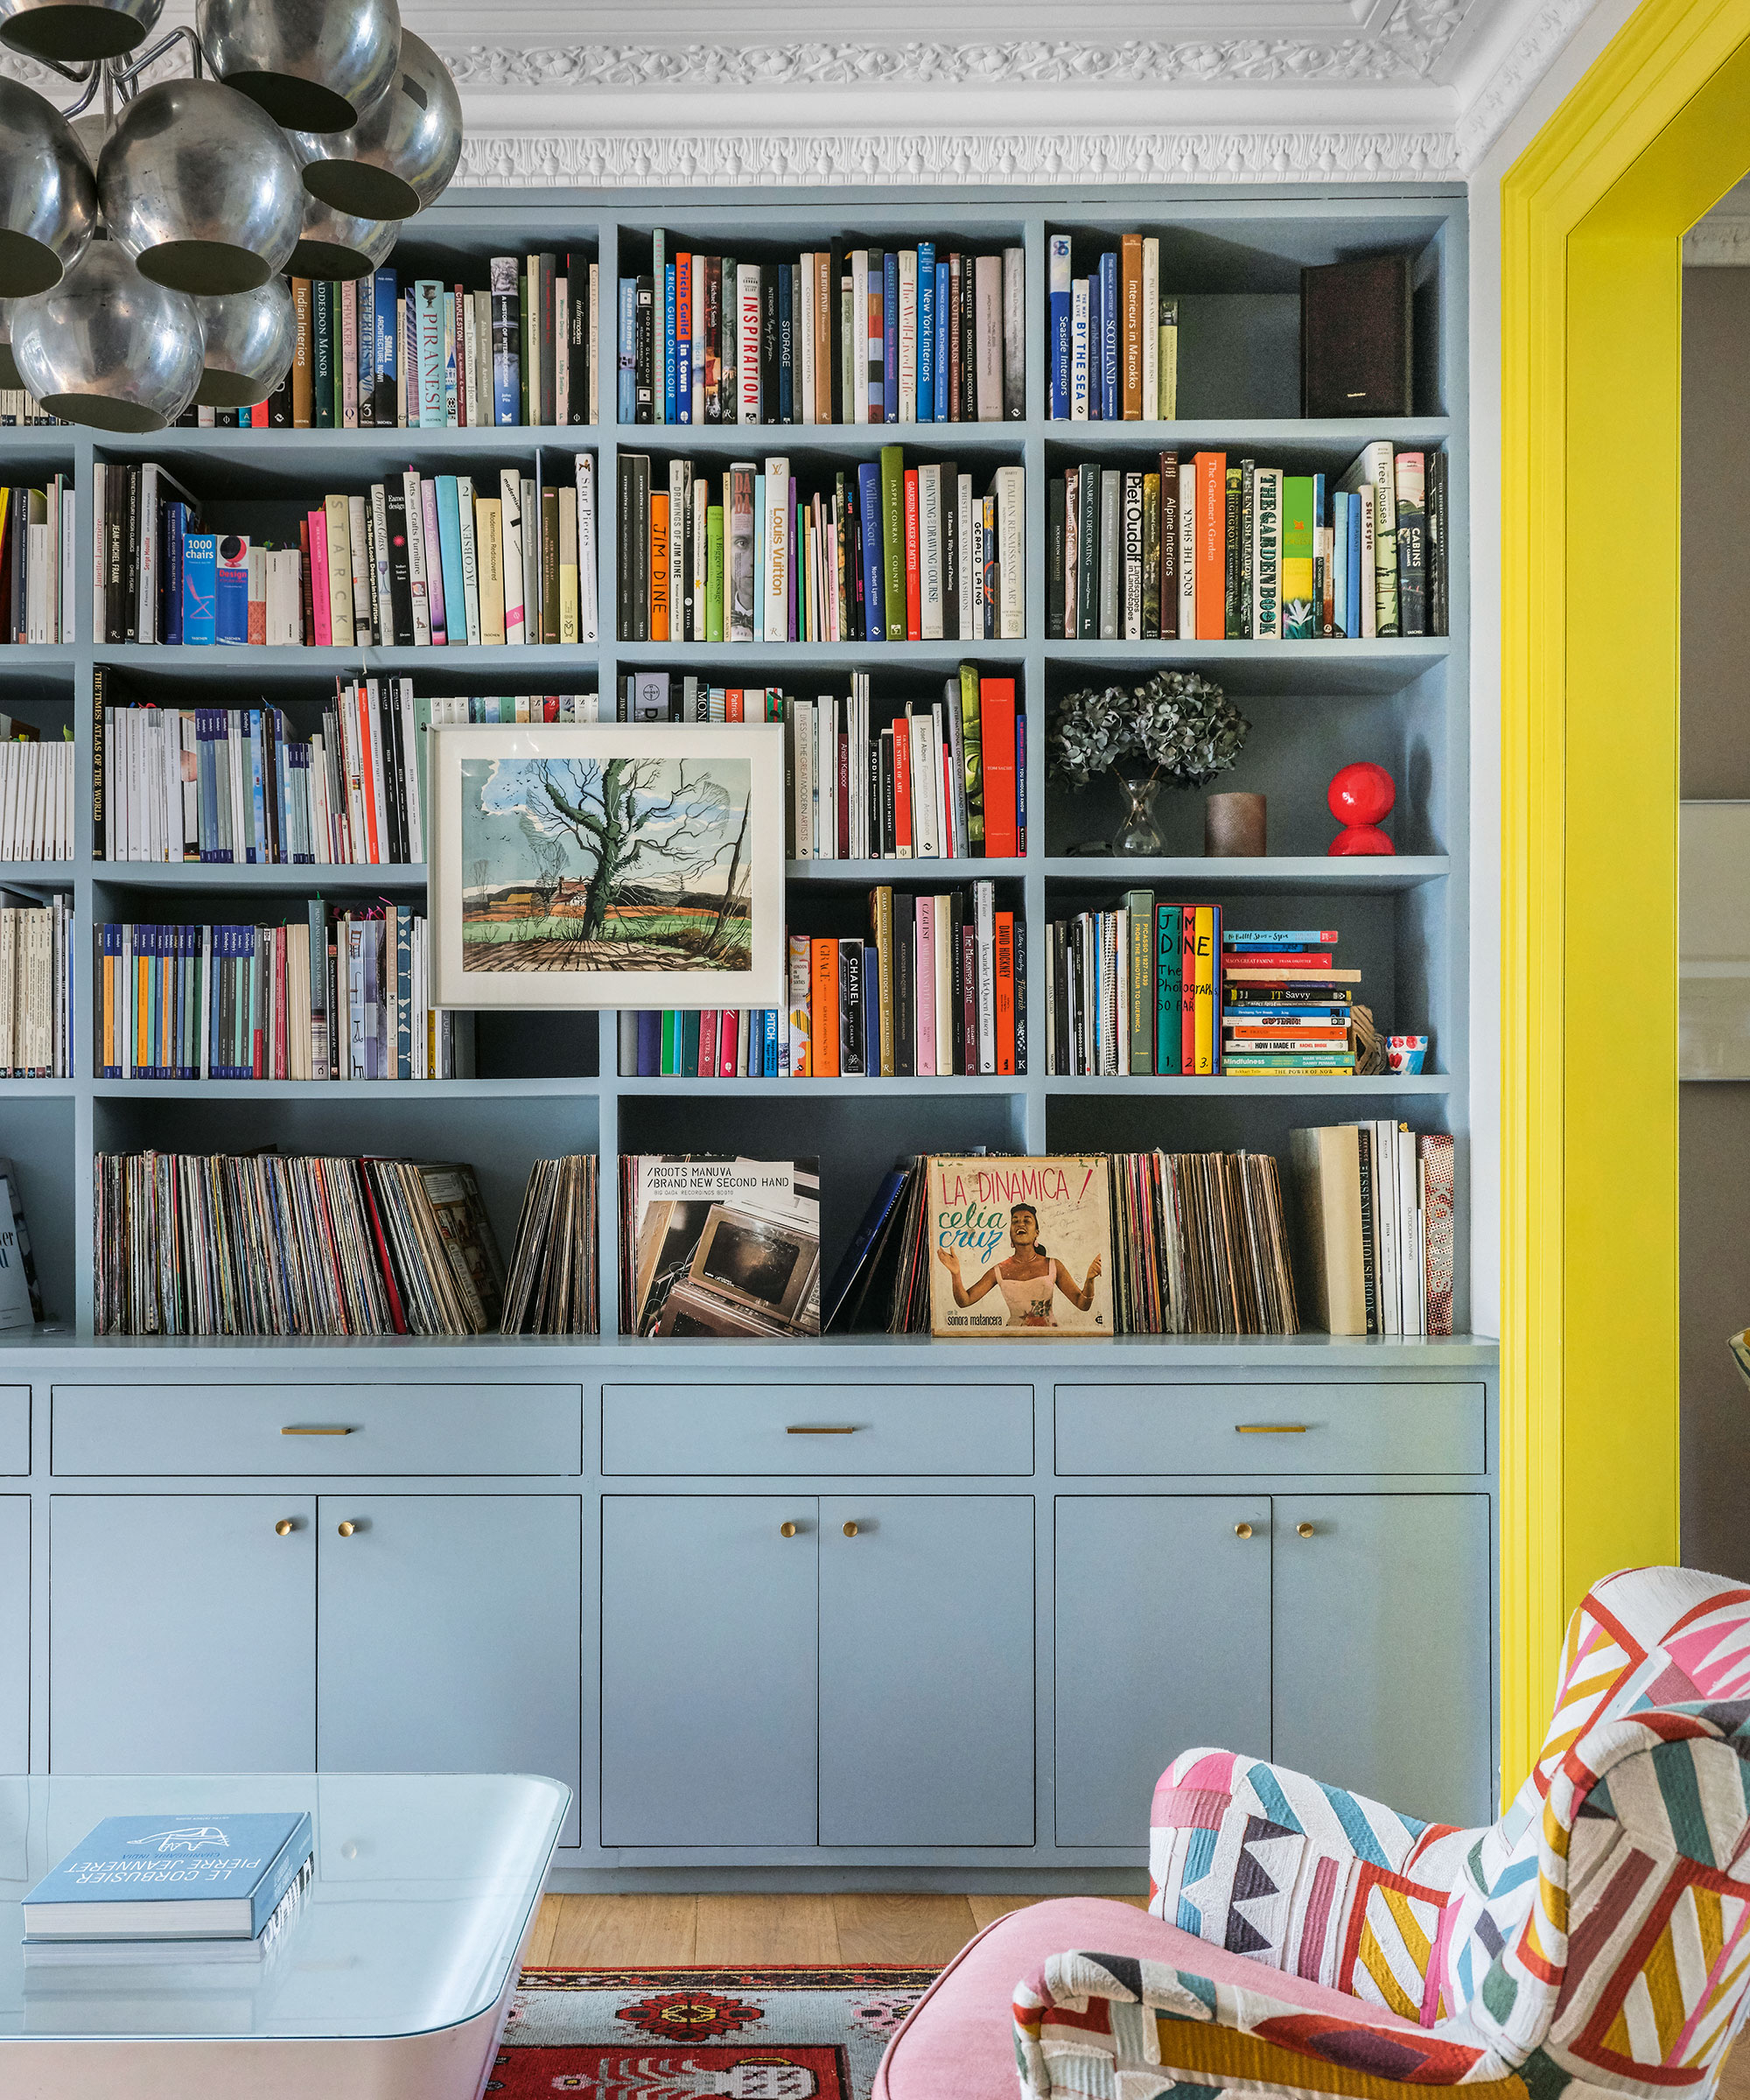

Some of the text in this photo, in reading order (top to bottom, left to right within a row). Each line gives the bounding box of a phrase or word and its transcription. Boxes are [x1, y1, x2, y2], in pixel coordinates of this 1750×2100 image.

[298, 288, 306, 366] Indian Interiors
[680, 303, 689, 335] Guild
[923, 289, 932, 382] New York Interiors
[1077, 323, 1085, 338] BY
[1129, 280, 1138, 388] Interieurs in Marokko
[668, 340, 674, 354] ON
[680, 345, 689, 356] in
[743, 296, 758, 404] INSPIRATION
[781, 320, 790, 367] STORAGE
[902, 280, 914, 396] The Well-Lived Life
[423, 313, 440, 411] PIRANESI
[680, 360, 689, 392] town
[1076, 374, 1085, 400] SEA
[1006, 480, 1015, 517] ITALIAN
[1208, 480, 1216, 527] Gardener's
[1378, 462, 1391, 524] tree houses
[410, 512, 419, 536] Crafts
[583, 509, 592, 547] Pieces
[865, 479, 877, 546] William Scott
[1127, 476, 1141, 562] Piet Oudolf
[188, 540, 212, 549] 1000
[674, 530, 681, 540] OF
[773, 508, 785, 596] Louis Vuitton
[1007, 520, 1016, 584] RENAISSANCE
[1164, 498, 1176, 576] Alpine Interiors
[1412, 528, 1421, 567] CABINS
[186, 550, 214, 558] chairs
[332, 501, 347, 624] STARCK
[463, 524, 474, 587] JACOBSEN
[111, 564, 120, 584] FRANK
[94, 754, 102, 766] OF
[897, 771, 902, 780] OF
[820, 945, 830, 982] GRACE
[999, 926, 1011, 977] DAVID HOCKNEY
[850, 958, 858, 1005] CHANEL
[983, 978, 991, 1012] McQueen
[1135, 990, 1140, 999] TO
[1286, 990, 1310, 1001] Savvy
[766, 1012, 776, 1040] PITCH
[647, 1167, 732, 1177] /ROOTS MANUVA
[647, 1177, 789, 1188] /BRAND NEW SECOND HAND
[942, 1173, 967, 1206] LA
[978, 1168, 1070, 1204] DINAMICA
[939, 1202, 1007, 1229] celia
[939, 1229, 1003, 1264] cruz
[1430, 1181, 1452, 1292] KOONS
[948, 1313, 1002, 1326] sonora matancera
[63, 1858, 262, 1873] PIERRE JEANNERET
[75, 1870, 232, 1884] LE CORBUSIER
